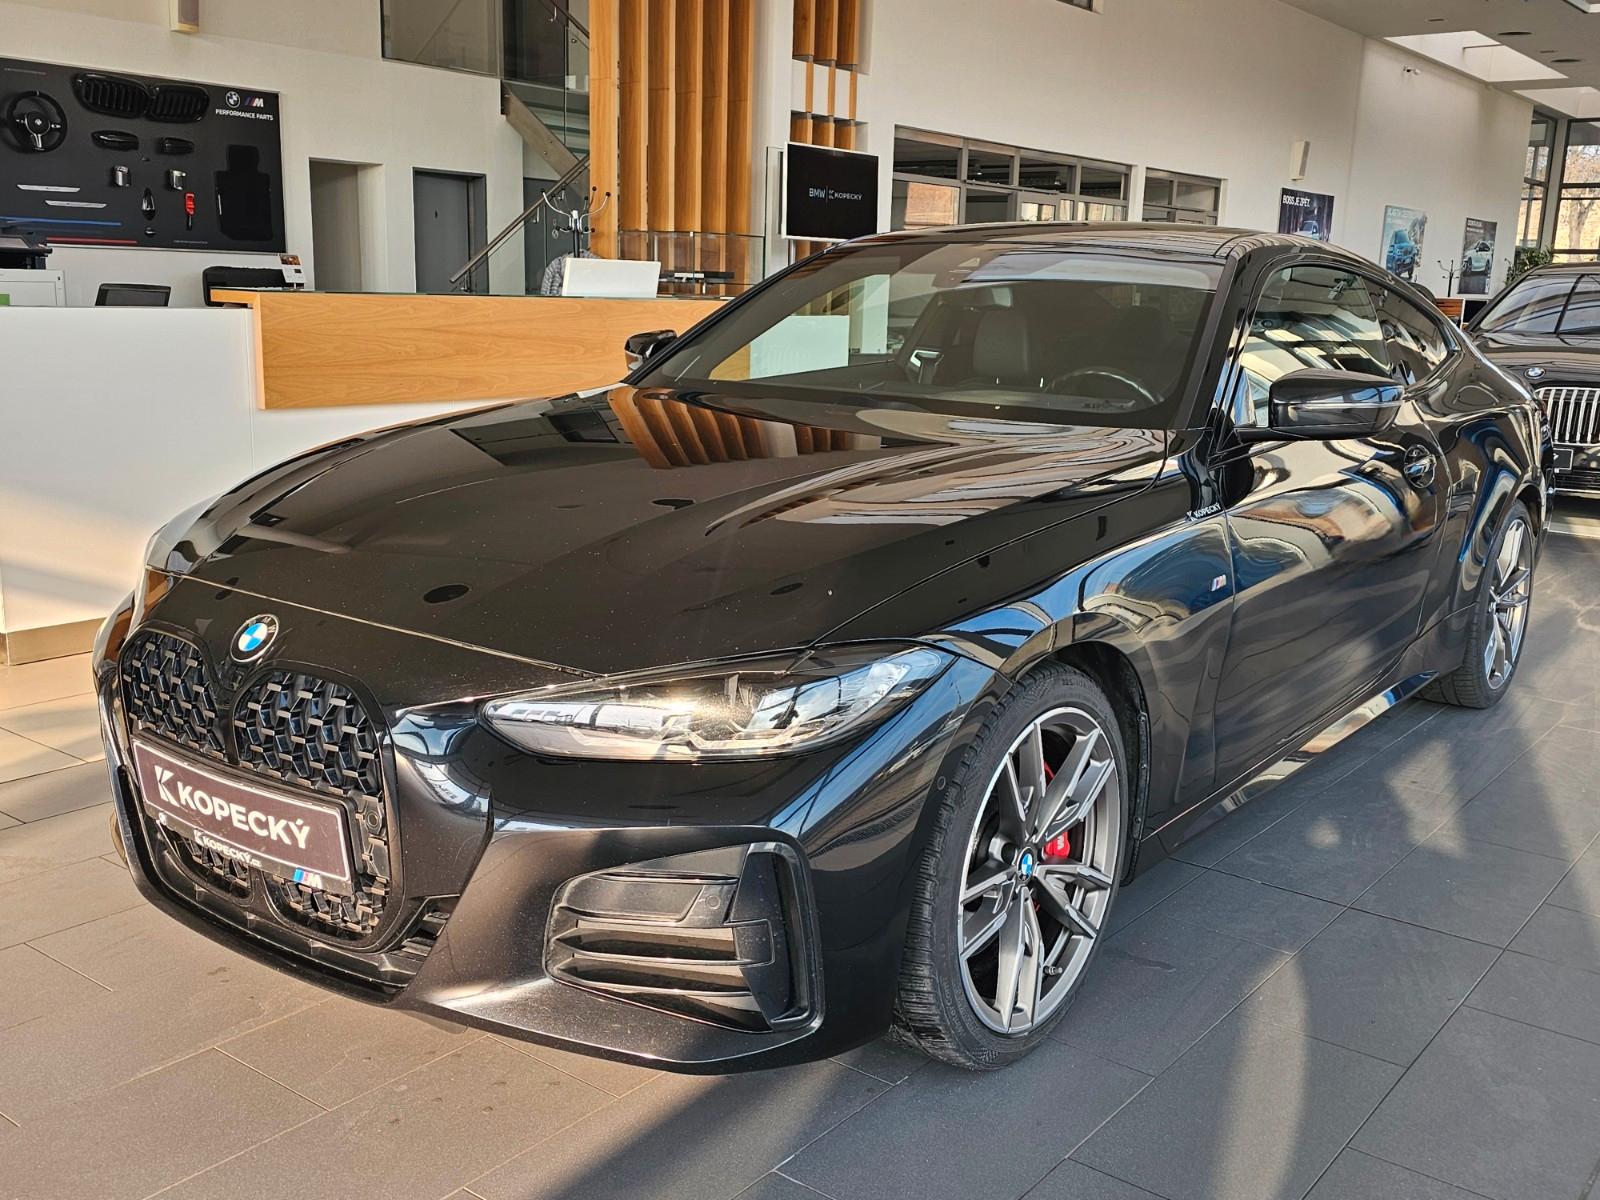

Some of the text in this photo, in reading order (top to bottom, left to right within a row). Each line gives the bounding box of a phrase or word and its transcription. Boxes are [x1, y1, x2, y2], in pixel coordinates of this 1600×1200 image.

[215, 108, 274, 121] PERFORMANCE PARTS
[809, 187, 826, 198] BMW
[1282, 195, 1295, 205] BOSS
[1295, 197, 1300, 206] JE
[176, 780, 311, 850] KOPECKÝ
